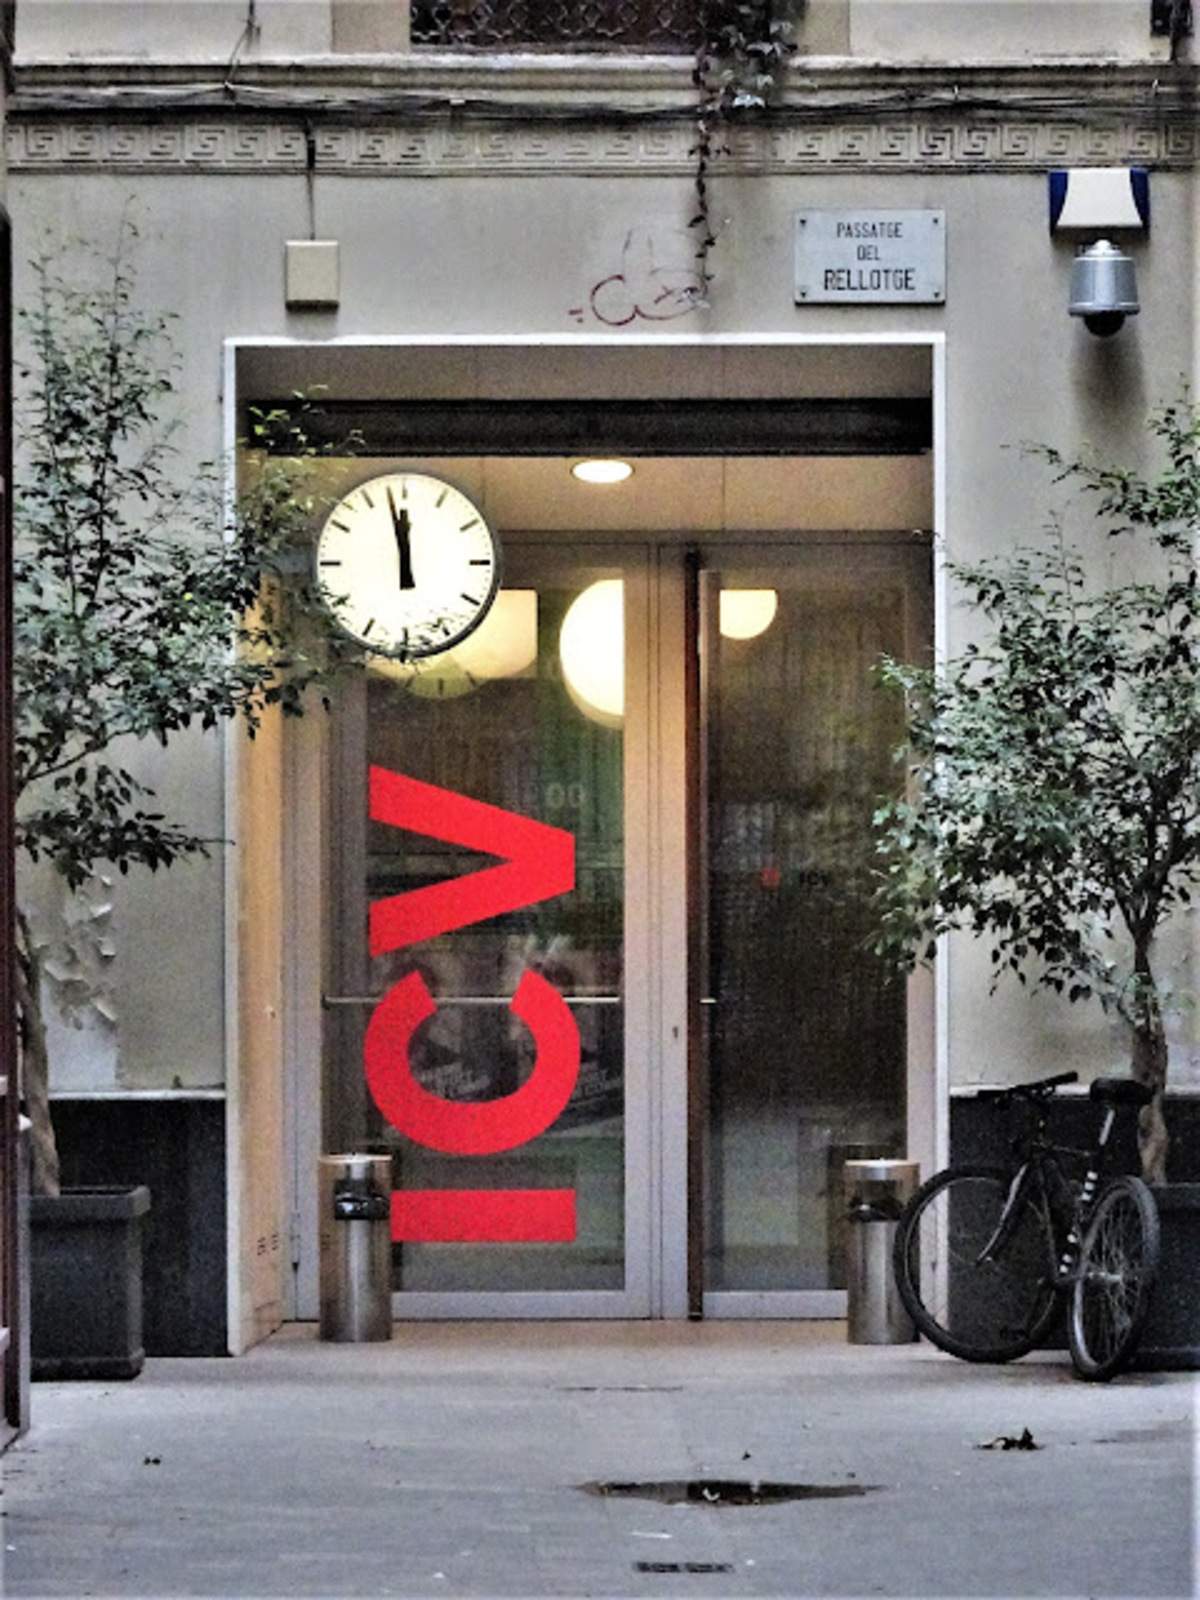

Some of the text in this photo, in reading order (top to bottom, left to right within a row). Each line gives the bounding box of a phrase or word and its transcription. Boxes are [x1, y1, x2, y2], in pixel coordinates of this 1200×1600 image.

[836, 222, 903, 238] PASSATGE
[856, 245, 881, 261] DEL
[823, 268, 916, 291] RELLOTGE
[364, 764, 581, 1243] ICV
